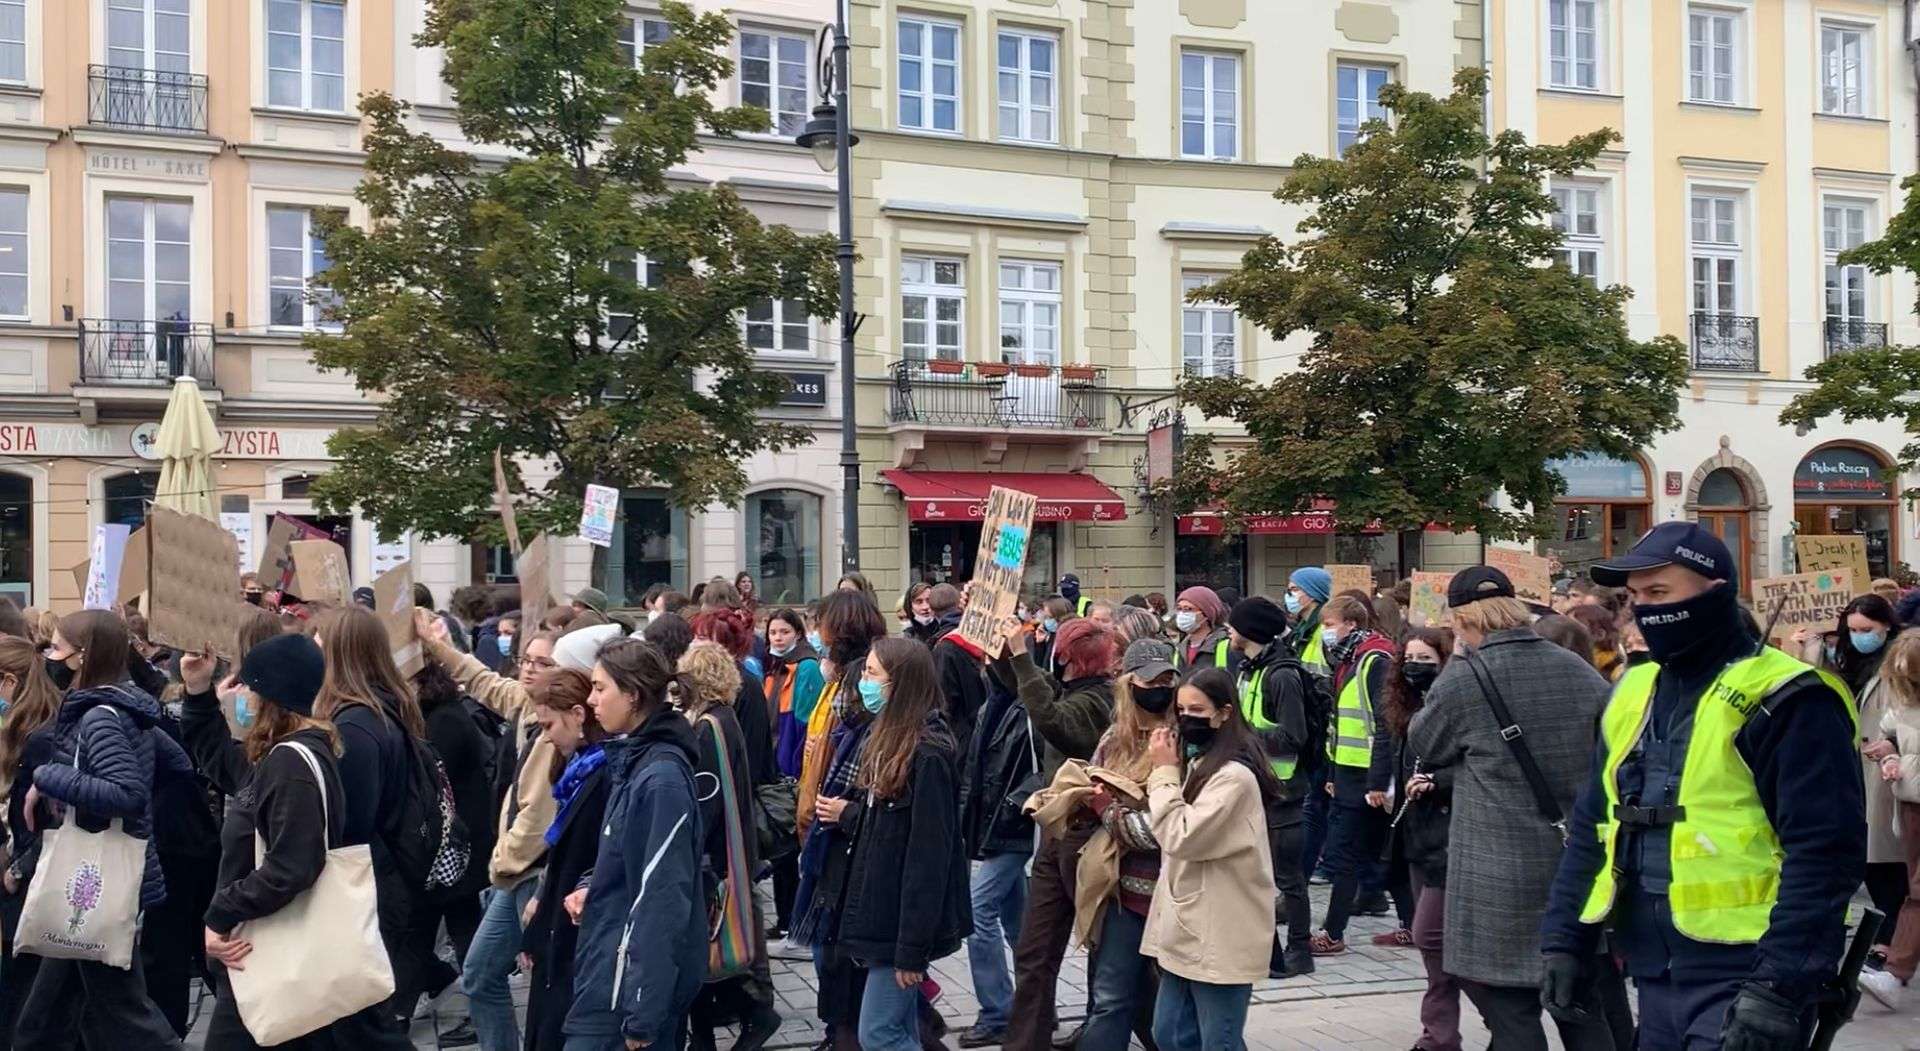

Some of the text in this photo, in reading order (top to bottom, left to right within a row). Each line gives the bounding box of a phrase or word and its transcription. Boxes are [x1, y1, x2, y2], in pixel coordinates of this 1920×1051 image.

[164, 159, 205, 176] SAXE
[218, 430, 280, 455] ZYSTA
[1675, 546, 1715, 569] POLICJA
[1810, 590, 1850, 608] WITH
